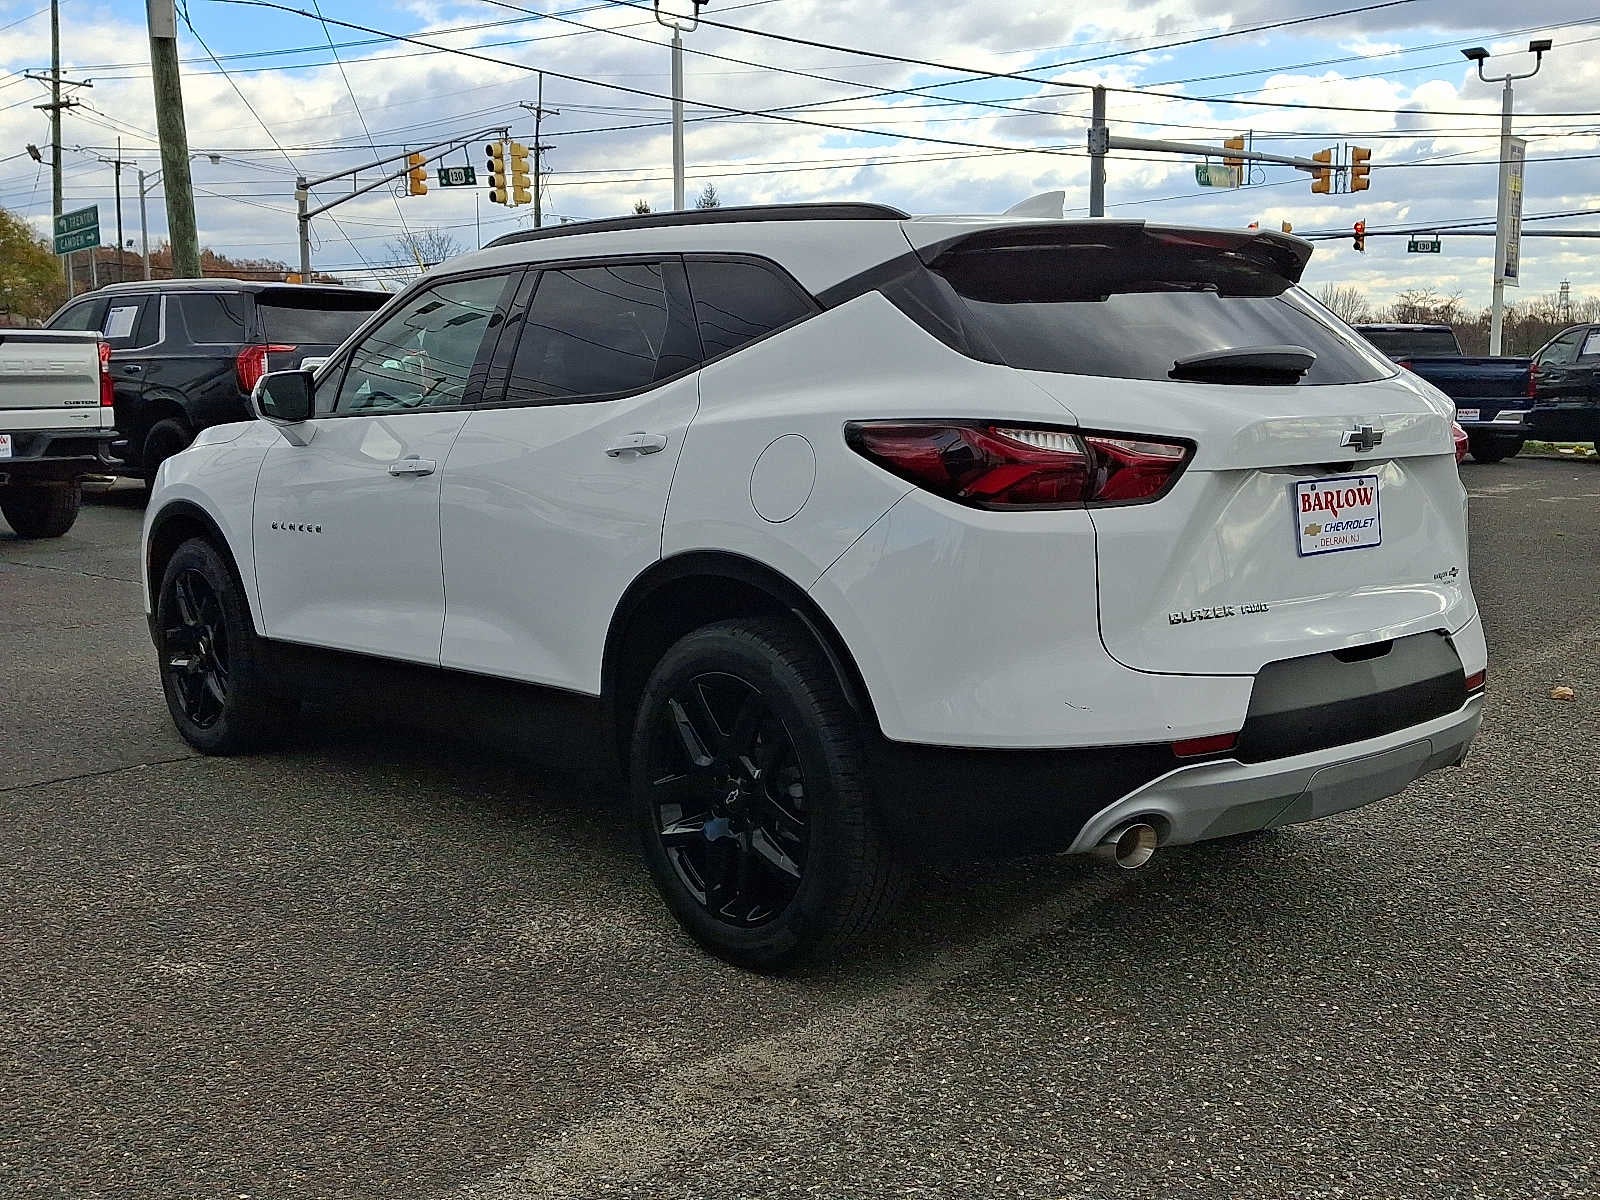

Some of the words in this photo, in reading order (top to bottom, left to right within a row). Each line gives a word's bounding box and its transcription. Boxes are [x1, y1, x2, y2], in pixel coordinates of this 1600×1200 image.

[451, 171, 463, 182] 130
[1301, 487, 1373, 518] BARLOW
[1324, 518, 1375, 533] CHEVROLET
[1320, 535, 1350, 547] DELRAN,
[1350, 533, 1360, 543] NJ
[1168, 604, 1235, 625] BLAZER
[1241, 602, 1269, 614] AWD
